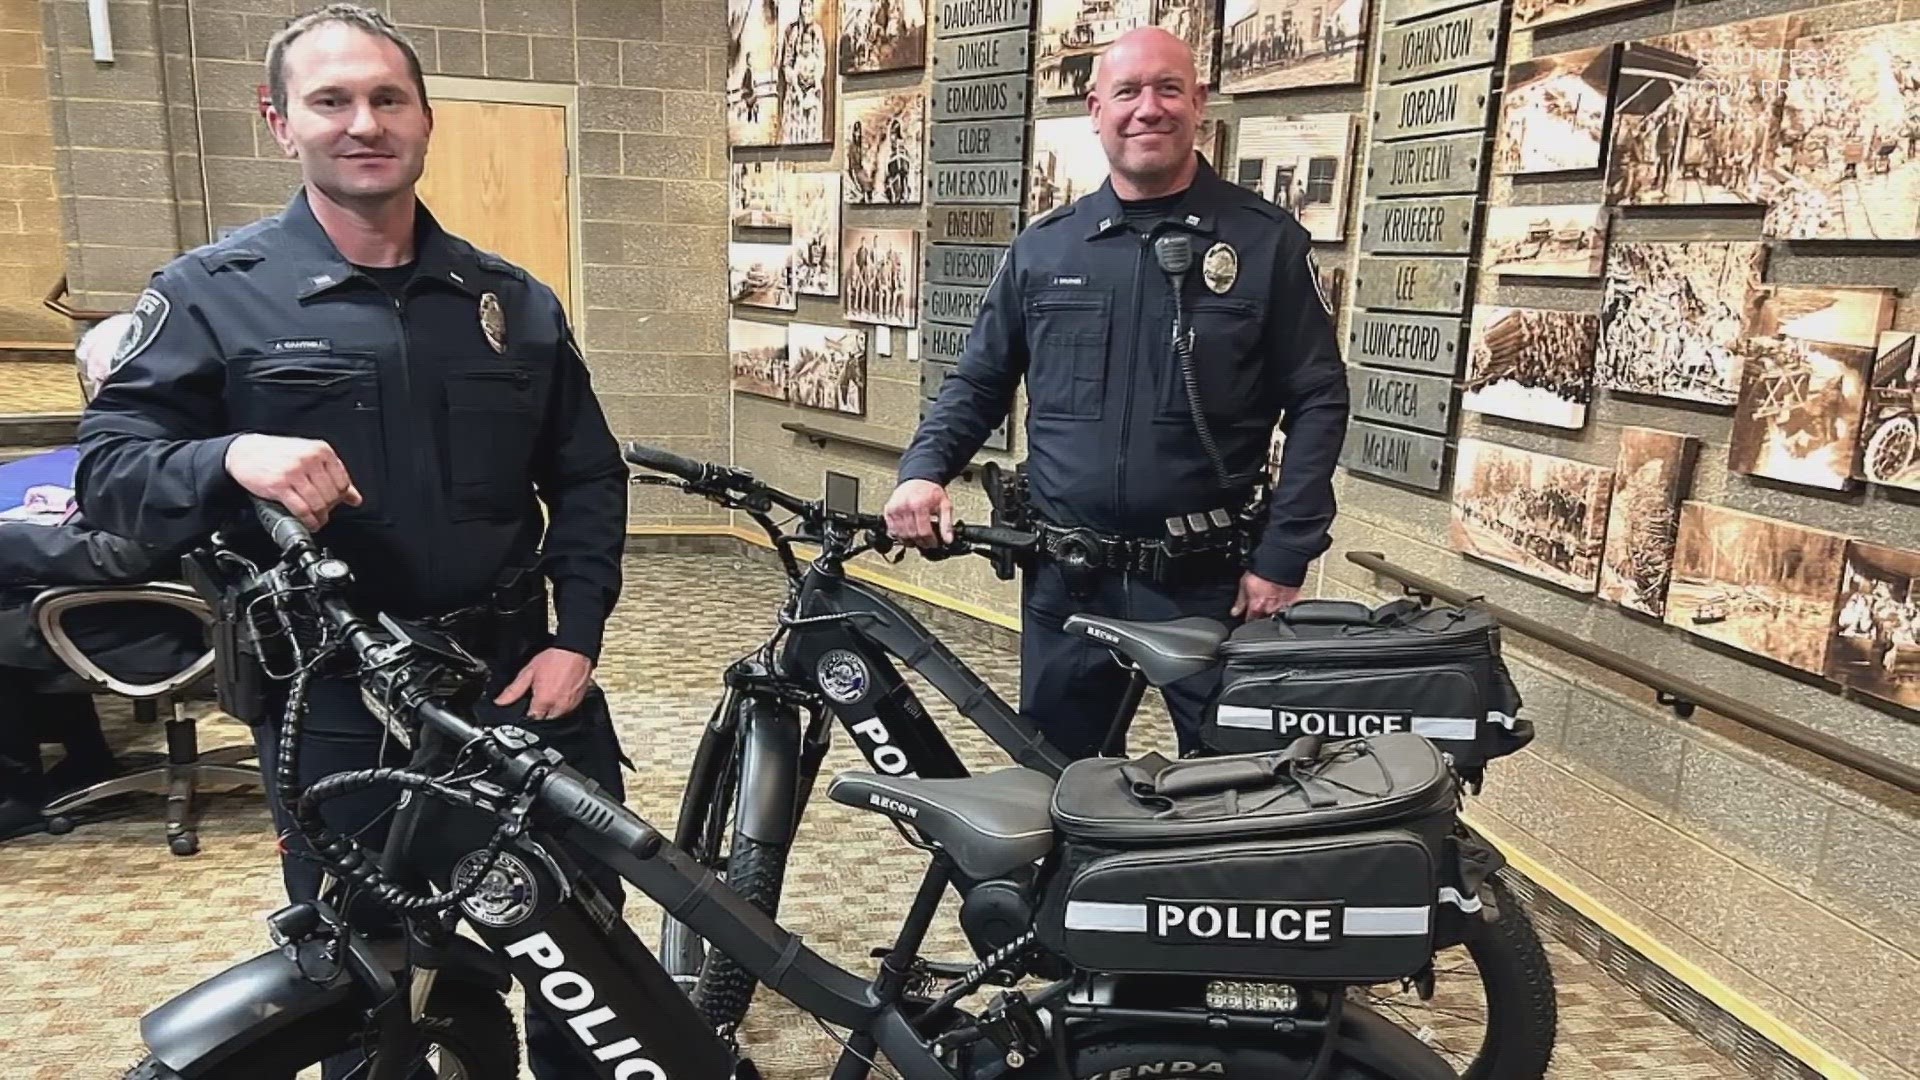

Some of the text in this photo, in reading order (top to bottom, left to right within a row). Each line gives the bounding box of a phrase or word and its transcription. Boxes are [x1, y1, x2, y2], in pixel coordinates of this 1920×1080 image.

[943, 0, 1017, 30] DAUGHARTY
[957, 40, 999, 71] DINGLE
[1397, 17, 1473, 71] JOHNSTON
[946, 83, 1008, 113] EDMONDS
[1397, 84, 1458, 129] JORDAN
[957, 128, 991, 155] ELDER
[1389, 144, 1453, 186] JURVELIN
[937, 169, 1009, 197] EMERSON
[946, 210, 995, 238] ENGLISH
[1382, 205, 1446, 242] KRUEGER
[1395, 266, 1419, 301] LEE
[931, 290, 985, 318] GUMPRE
[932, 329, 970, 357] HAGA
[1361, 321, 1440, 362] LUNCEFORD
[1366, 377, 1418, 418] McCREA
[1362, 432, 1411, 473] McLAIN
[1278, 710, 1402, 737] POLICE
[852, 715, 921, 780] PO
[869, 792, 919, 819] RECON
[1157, 903, 1332, 943] POLICE
[1085, 1060, 1226, 1080] ENDA
